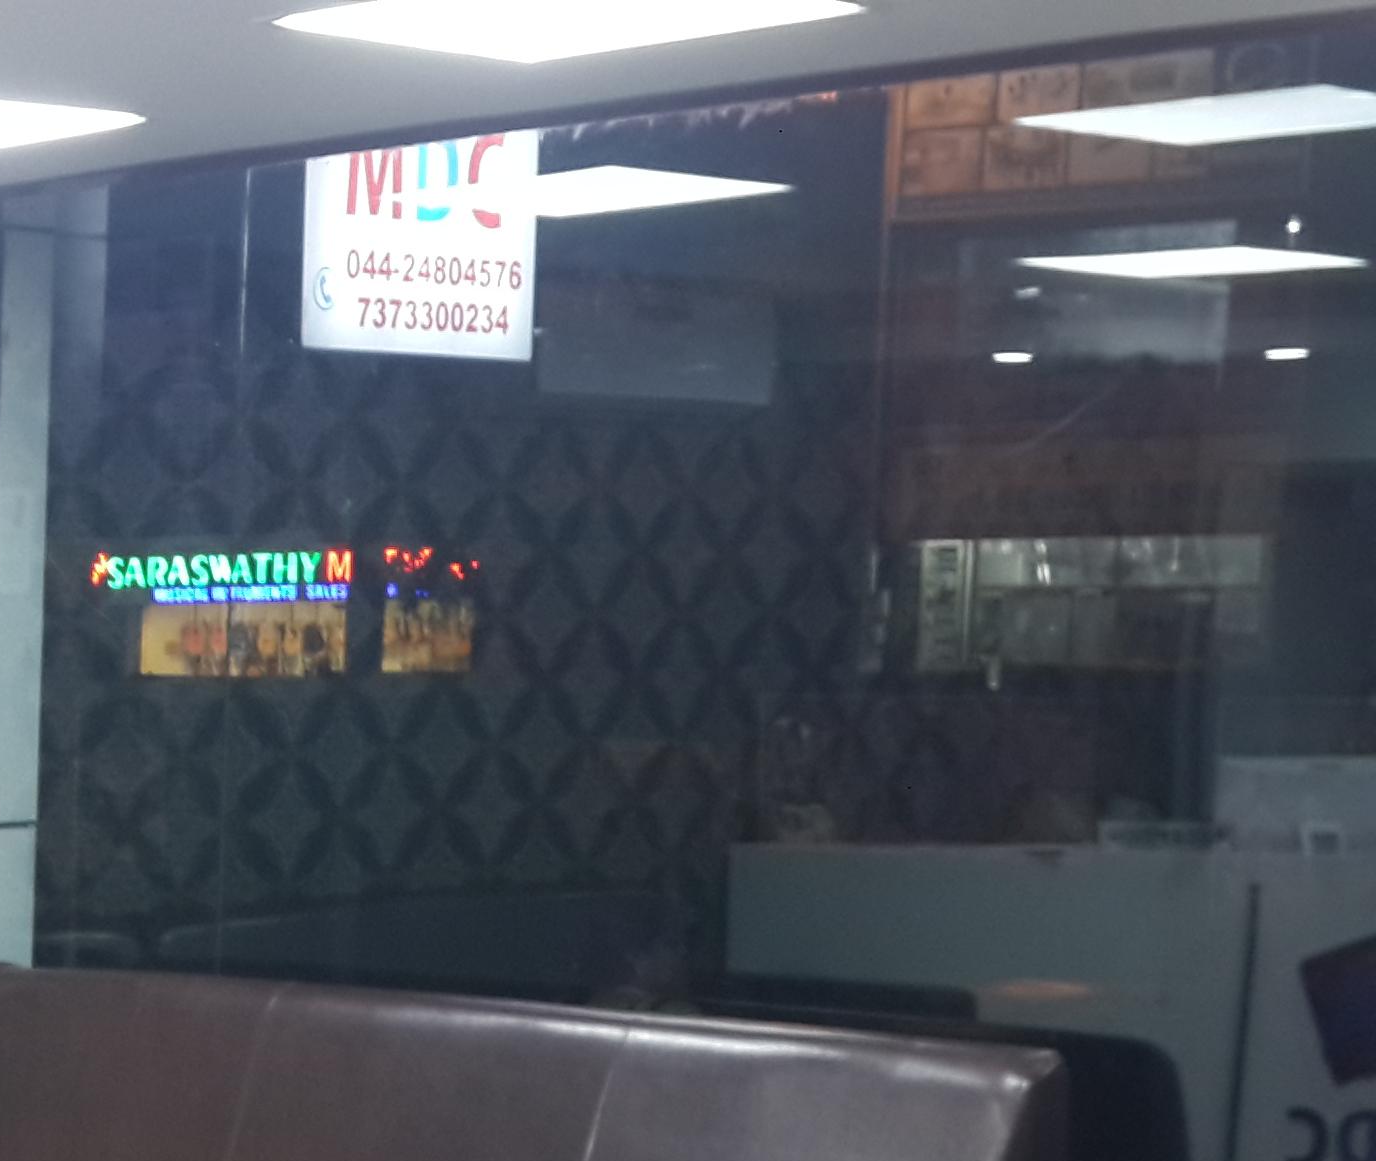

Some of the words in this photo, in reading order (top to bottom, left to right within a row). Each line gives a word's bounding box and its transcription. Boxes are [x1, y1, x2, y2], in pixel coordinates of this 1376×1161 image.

[346, 132, 505, 229] MDC
[347, 249, 522, 291] 044-24804576
[357, 297, 509, 335] 7373300234
[106, 550, 322, 590] SARASWATHY
